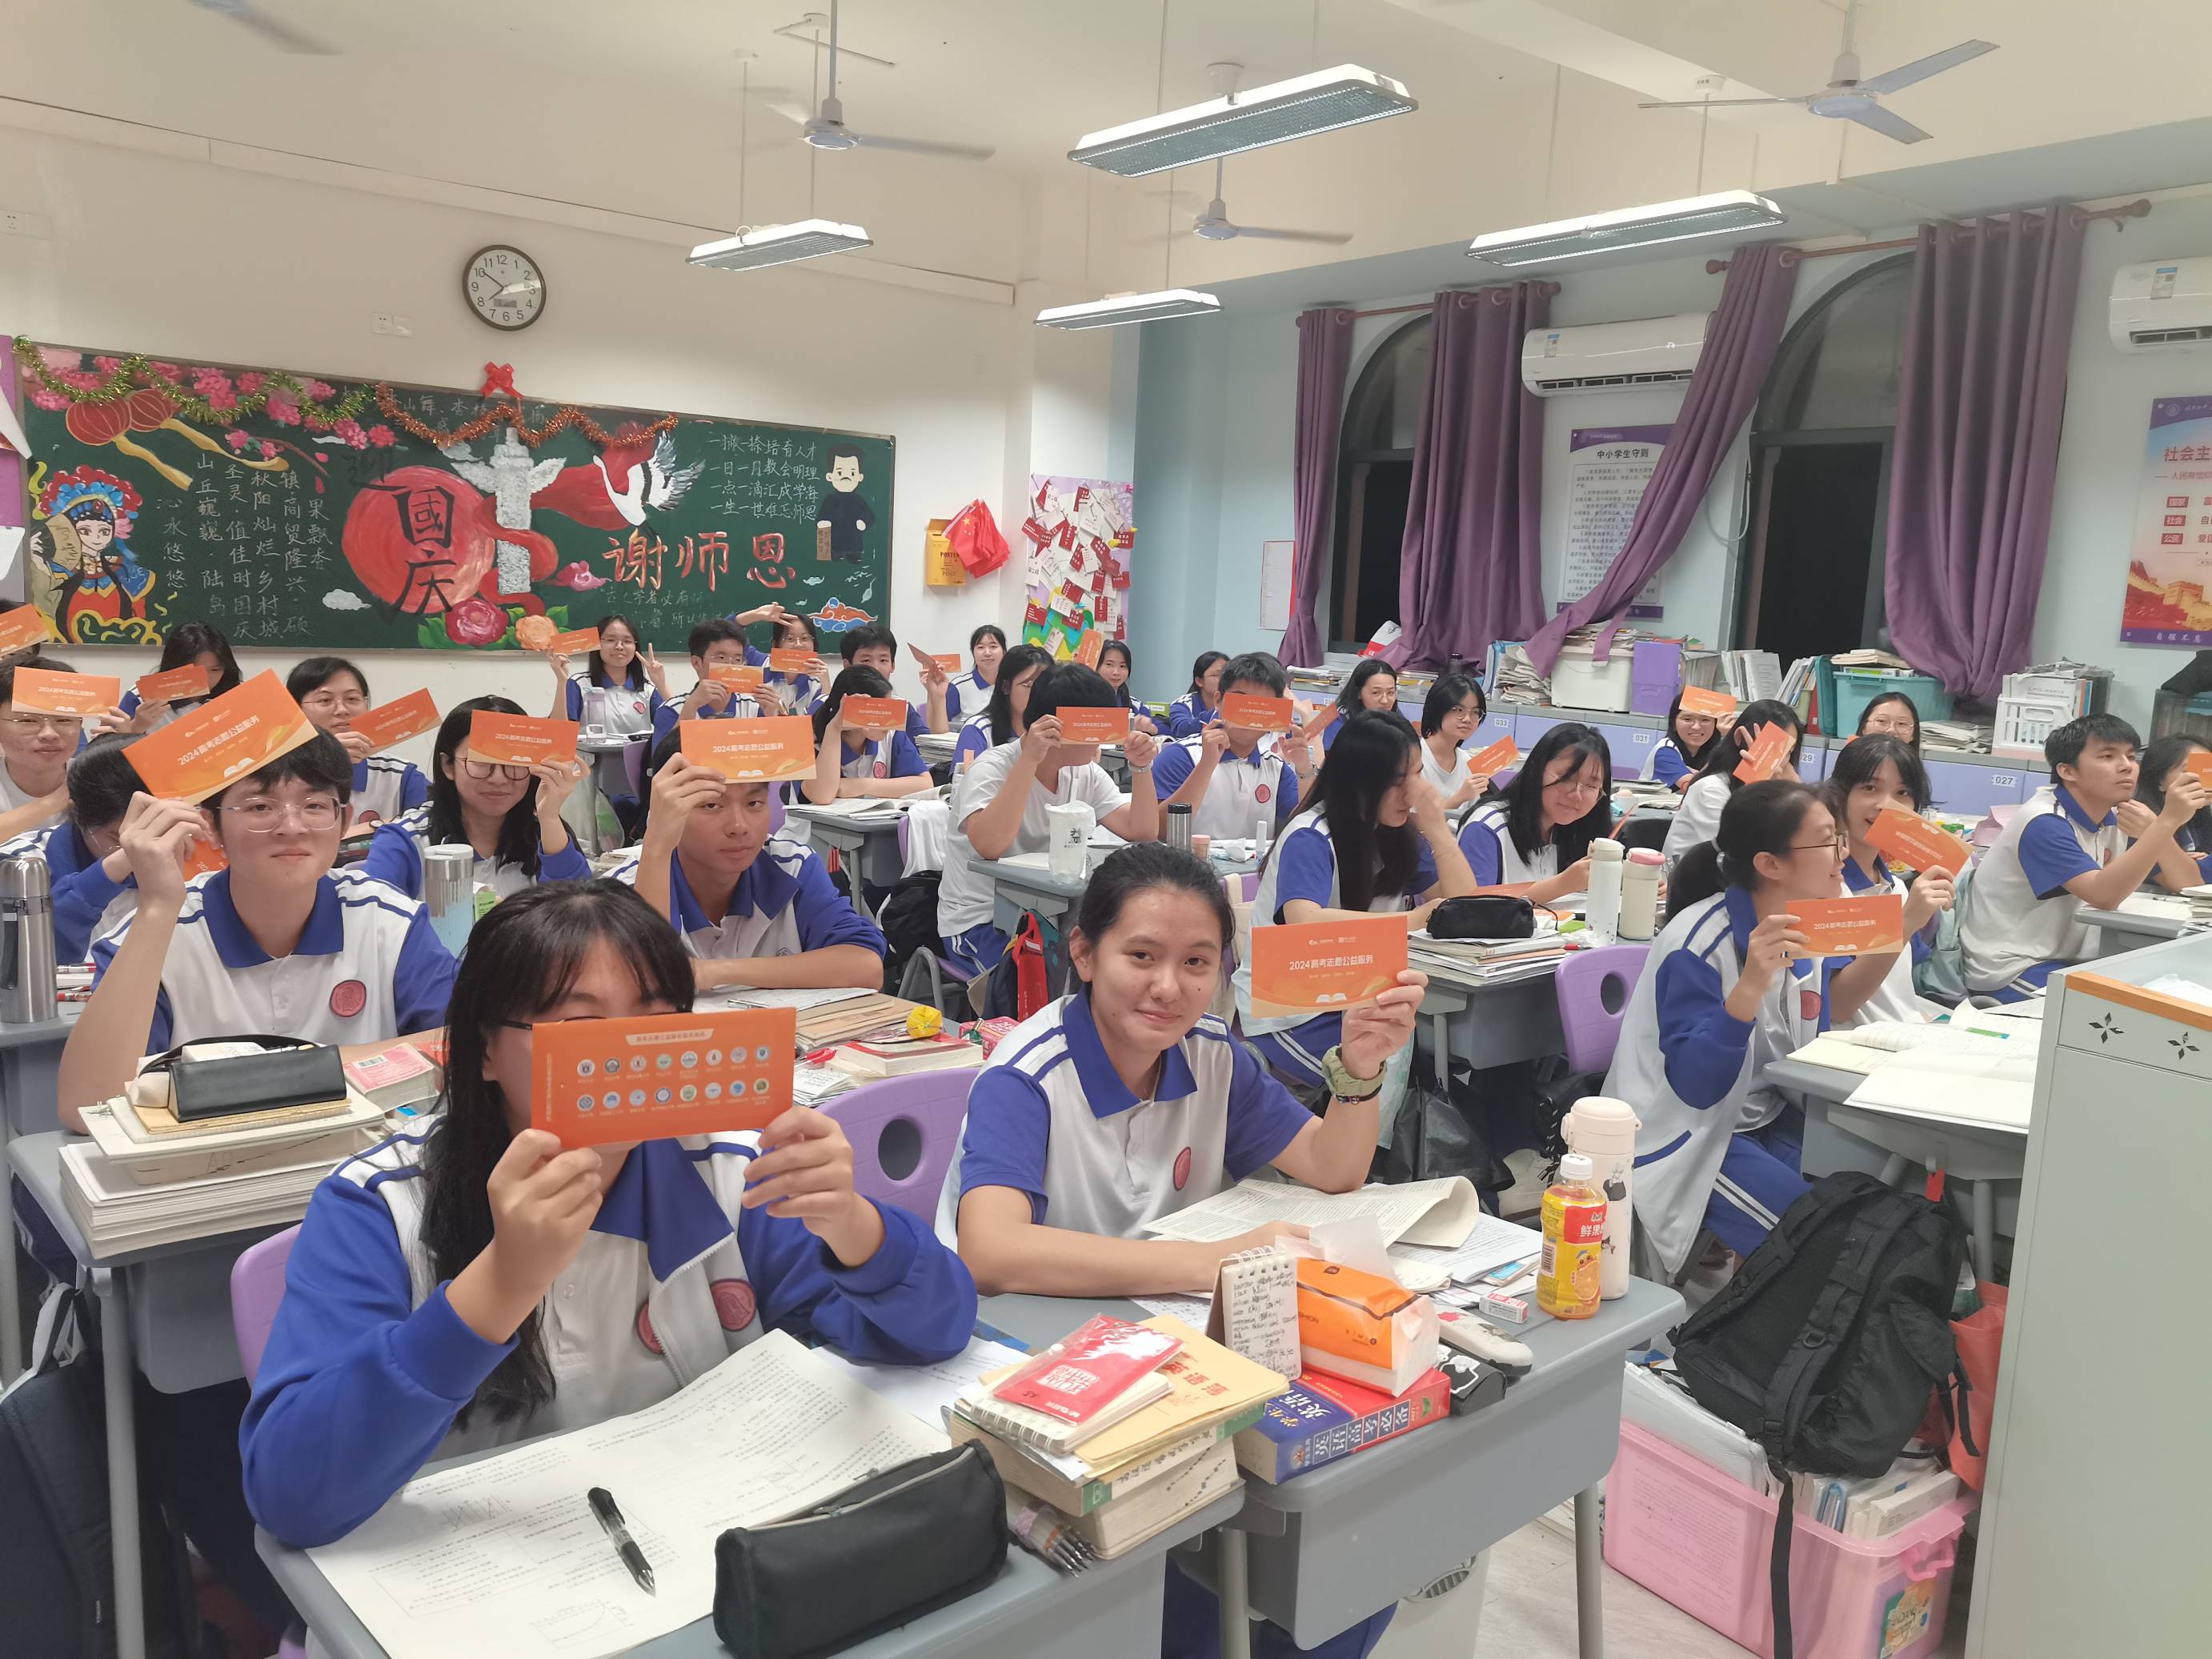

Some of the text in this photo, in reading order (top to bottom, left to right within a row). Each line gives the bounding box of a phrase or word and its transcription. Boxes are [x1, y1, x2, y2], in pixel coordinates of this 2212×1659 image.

[484, 258, 493, 268] 11
[496, 254, 507, 265] 12
[474, 267, 486, 278] 10
[523, 270, 531, 280] 2
[471, 282, 479, 292] 9
[477, 297, 485, 307] 8
[526, 299, 533, 308] 4
[489, 308, 496, 319] 7
[503, 311, 510, 321] 6
[517, 310, 524, 320] 5
[1597, 447, 1649, 459] 中小学生守则
[2163, 445, 2212, 462] 社会主
[710, 458, 819, 481] 一日一月教会明理
[711, 480, 818, 503] 一点一滴汇成学海
[711, 498, 817, 524] 一生一世难忘师恩
[2164, 534, 2180, 543] 公民
[602, 527, 795, 592] 谢师恩
[1802, 754, 1813, 762] 29
[1995, 775, 2014, 785] 027
[1279, 1389, 1332, 1420] 英语
